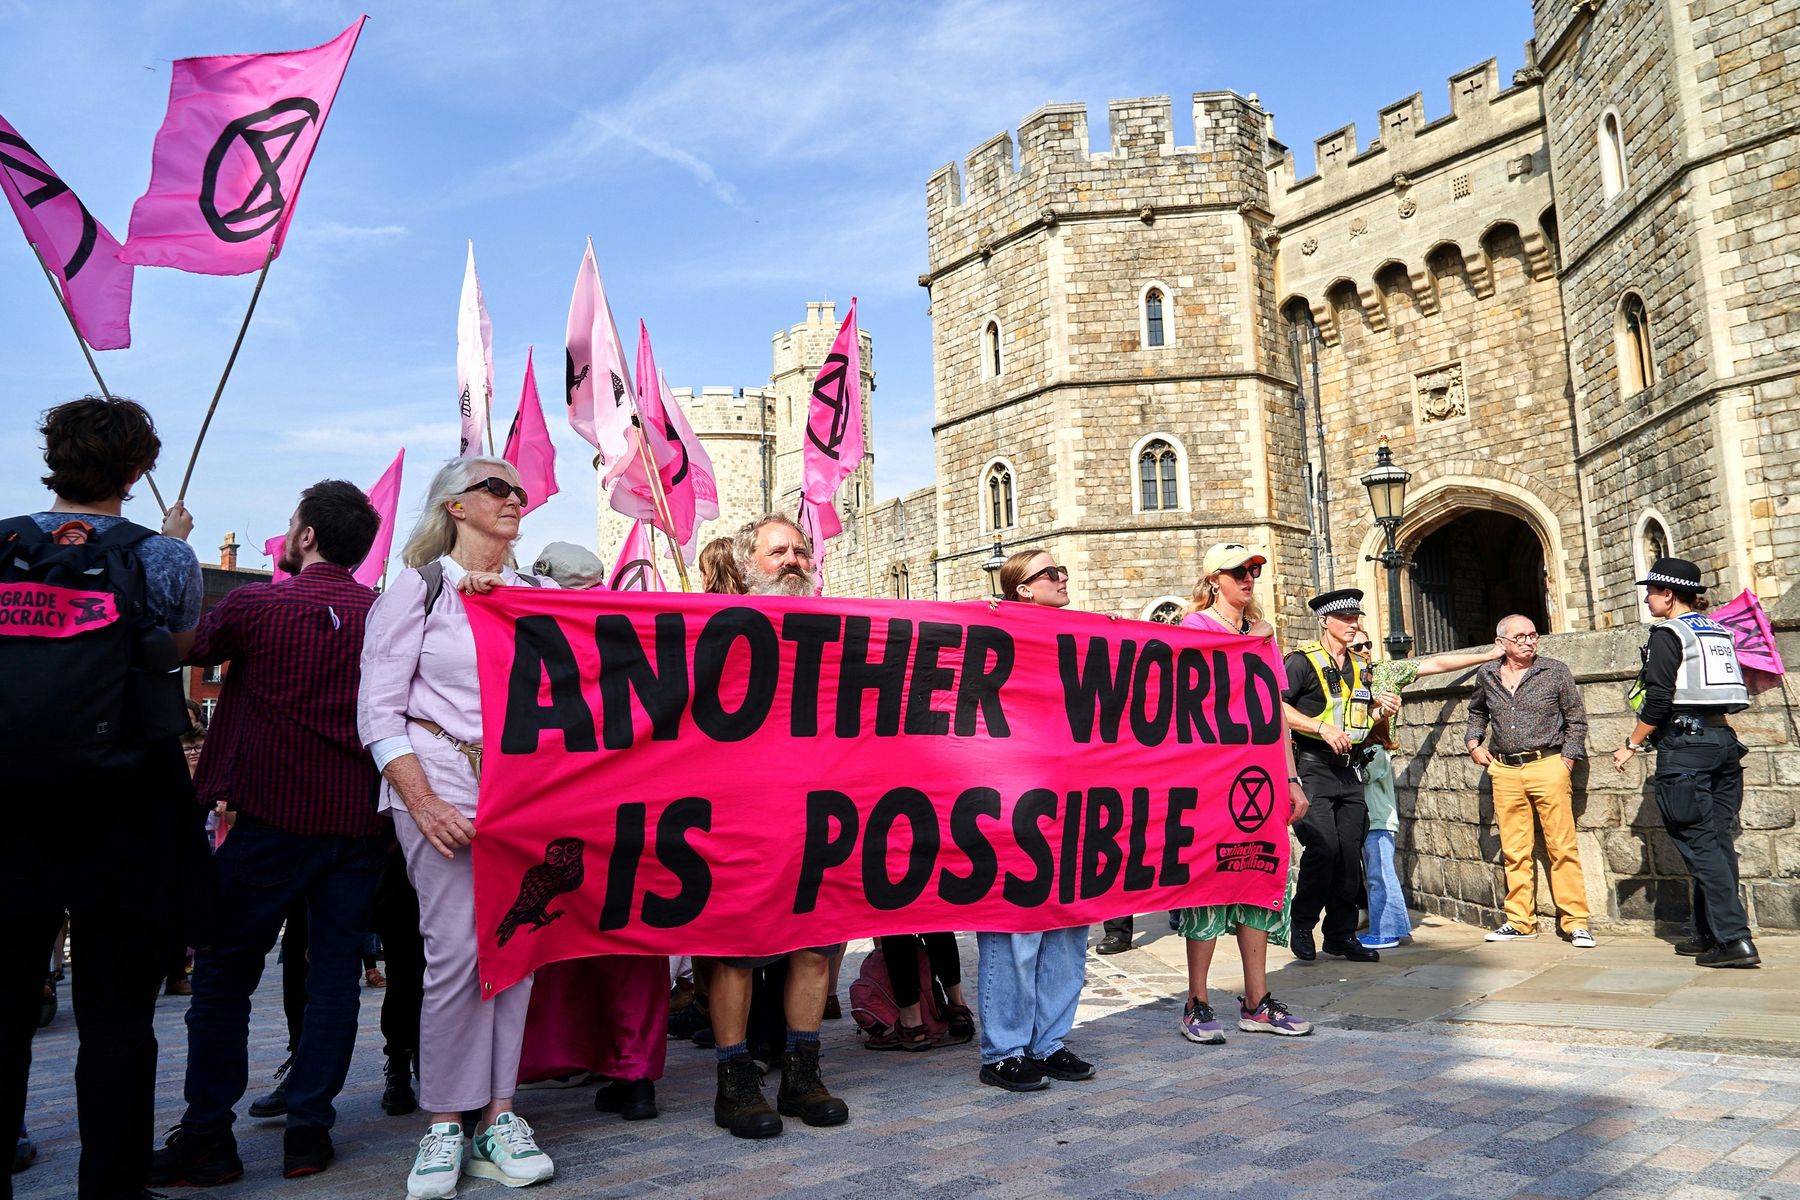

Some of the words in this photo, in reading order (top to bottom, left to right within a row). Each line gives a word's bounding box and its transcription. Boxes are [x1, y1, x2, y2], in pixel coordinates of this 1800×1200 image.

[0, 591, 56, 609] GRADE
[1725, 662, 1734, 673] B
[501, 606, 1015, 755] ANOTHER
[1056, 633, 1282, 747] WORLD
[597, 796, 713, 933] IS
[792, 786, 1198, 915] POSSIBLE
[1228, 855, 1275, 871] rebellion
